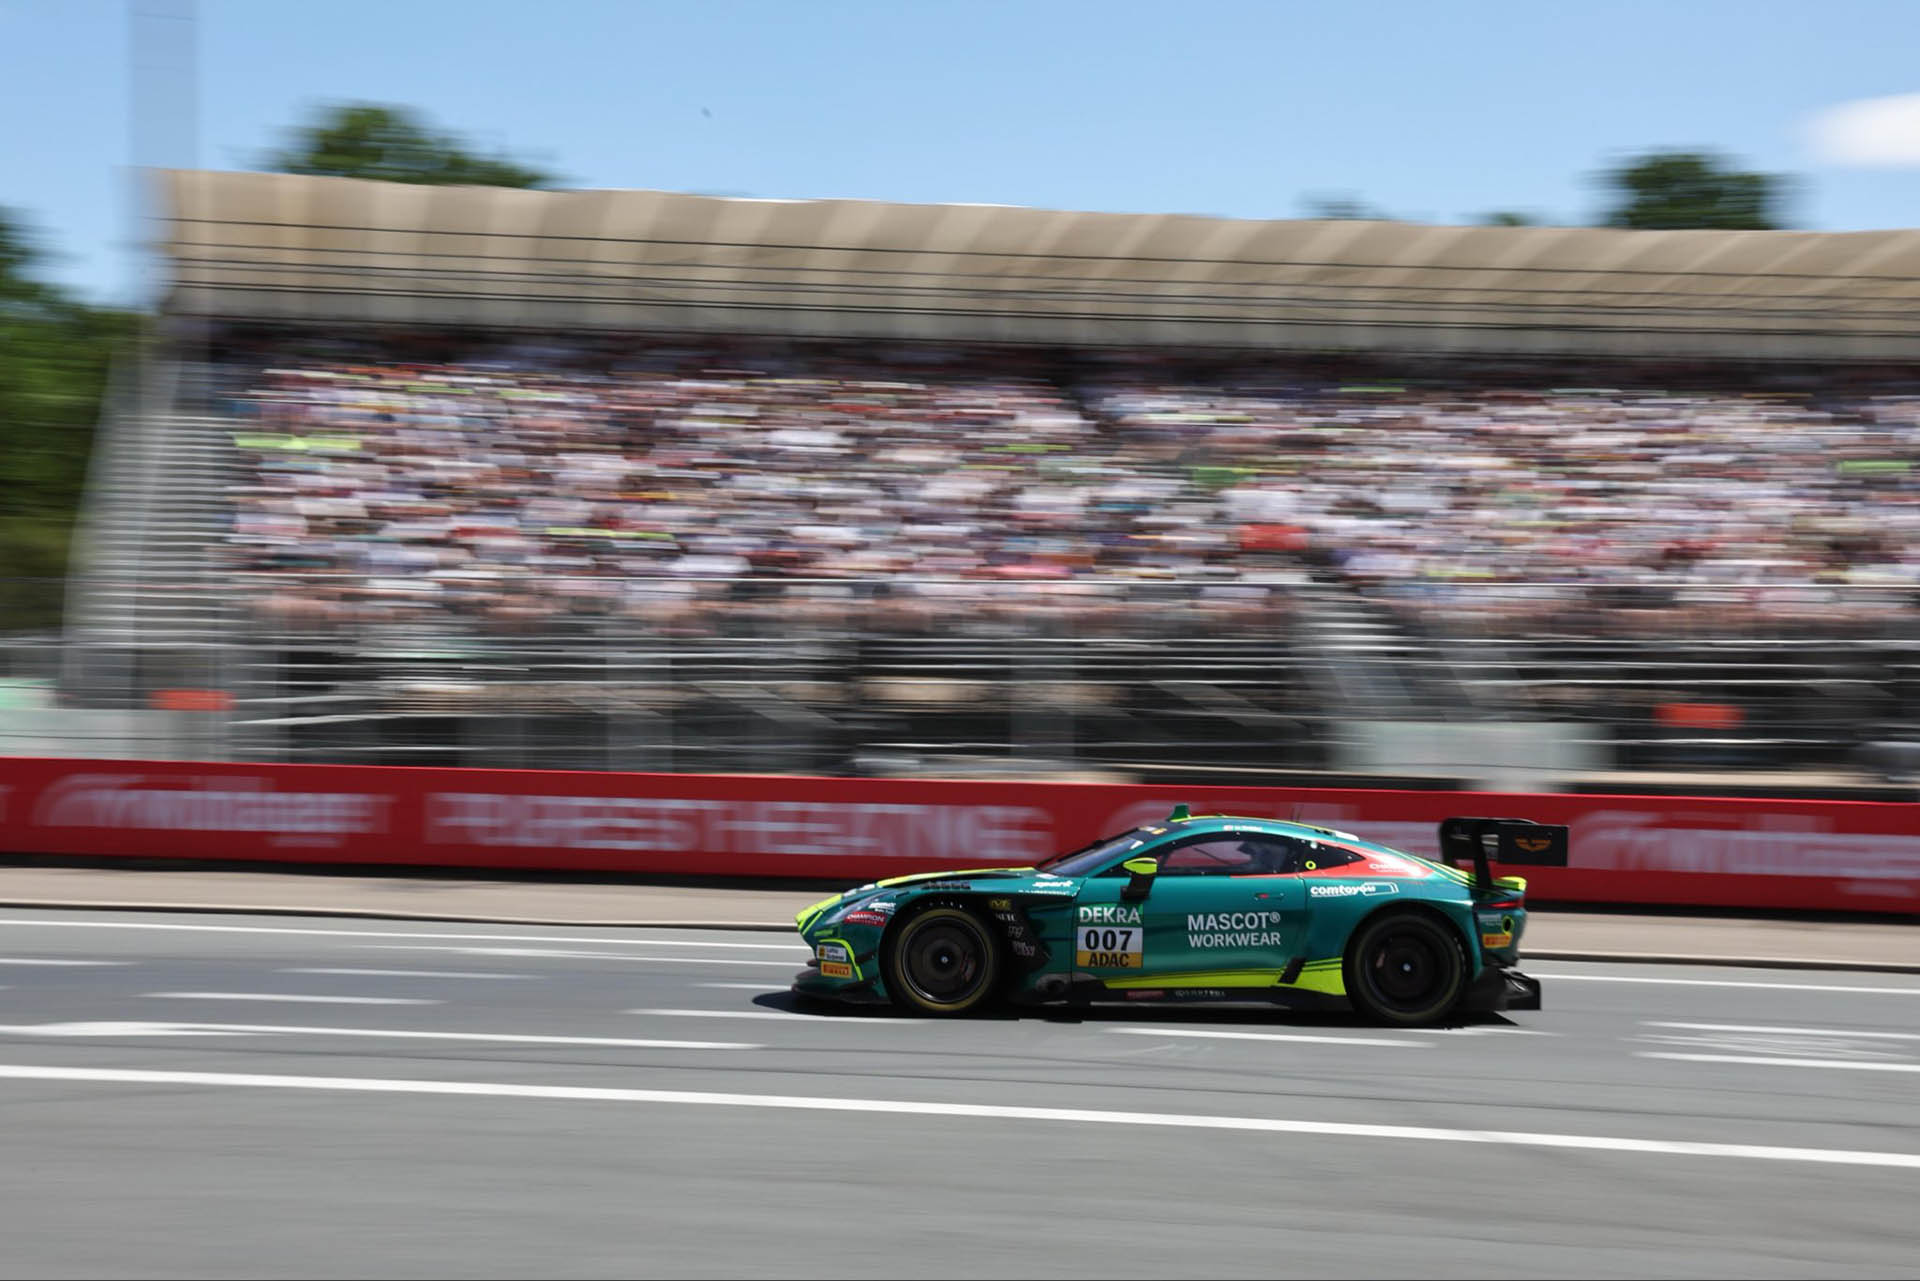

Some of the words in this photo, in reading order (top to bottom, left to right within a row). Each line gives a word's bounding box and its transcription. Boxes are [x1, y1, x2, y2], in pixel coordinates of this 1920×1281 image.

[847, 913, 885, 922] CHAMPION
[1079, 906, 1142, 924] DEKRA
[1085, 929, 1133, 951] 007
[1188, 932, 1281, 948] WORKWEAR
[1089, 953, 1130, 968] ADAC
